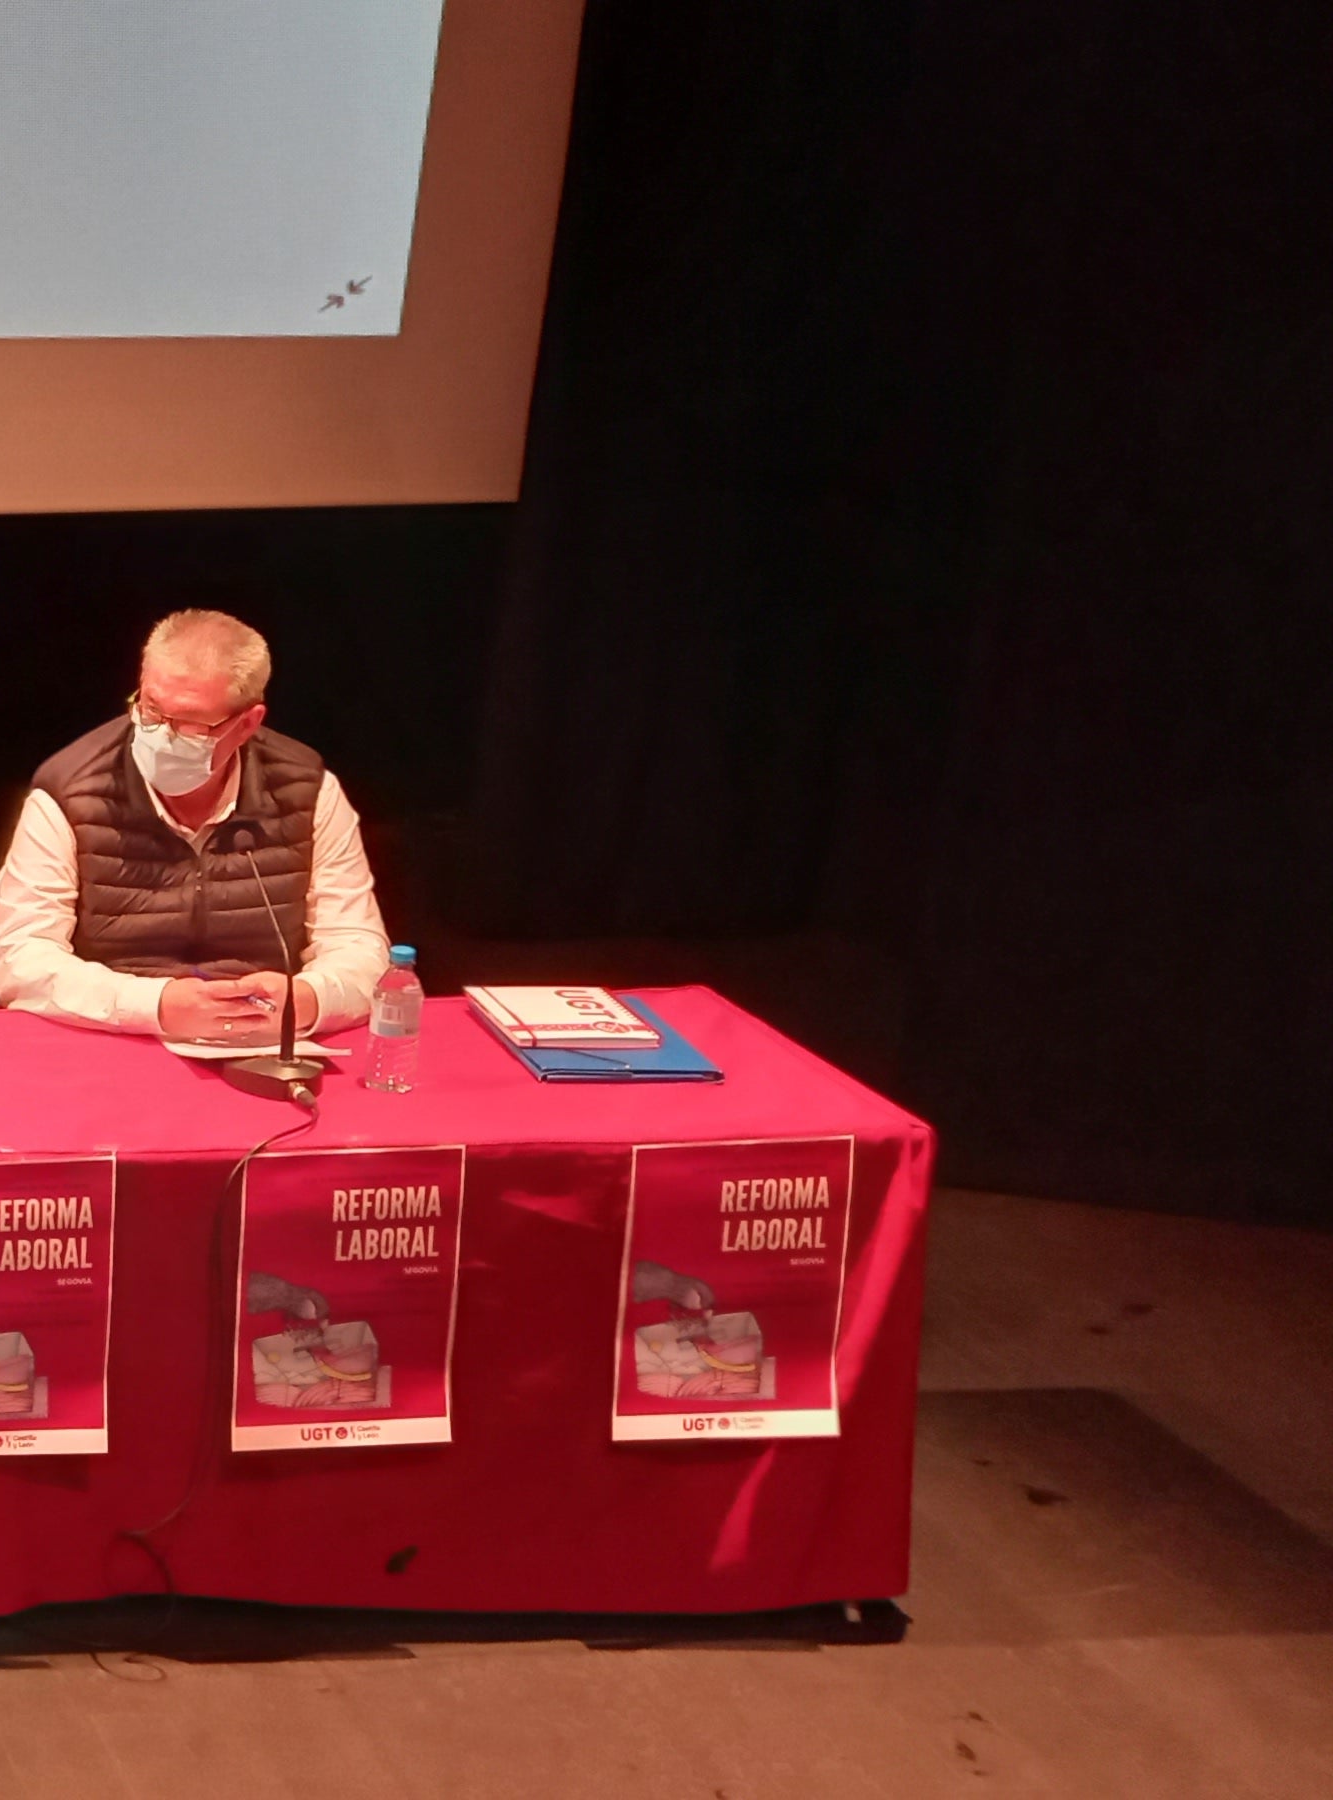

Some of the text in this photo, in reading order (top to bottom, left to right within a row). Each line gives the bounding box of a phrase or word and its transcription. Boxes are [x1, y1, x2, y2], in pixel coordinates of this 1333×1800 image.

[554, 989, 618, 1020] UGT
[333, 1185, 441, 1222] REFORMA
[720, 1176, 829, 1212] REFORMA
[335, 1226, 439, 1261] LABORAL
[721, 1217, 826, 1252] LABORAL
[300, 1427, 332, 1441] UGT
[682, 1418, 714, 1431] UGT
